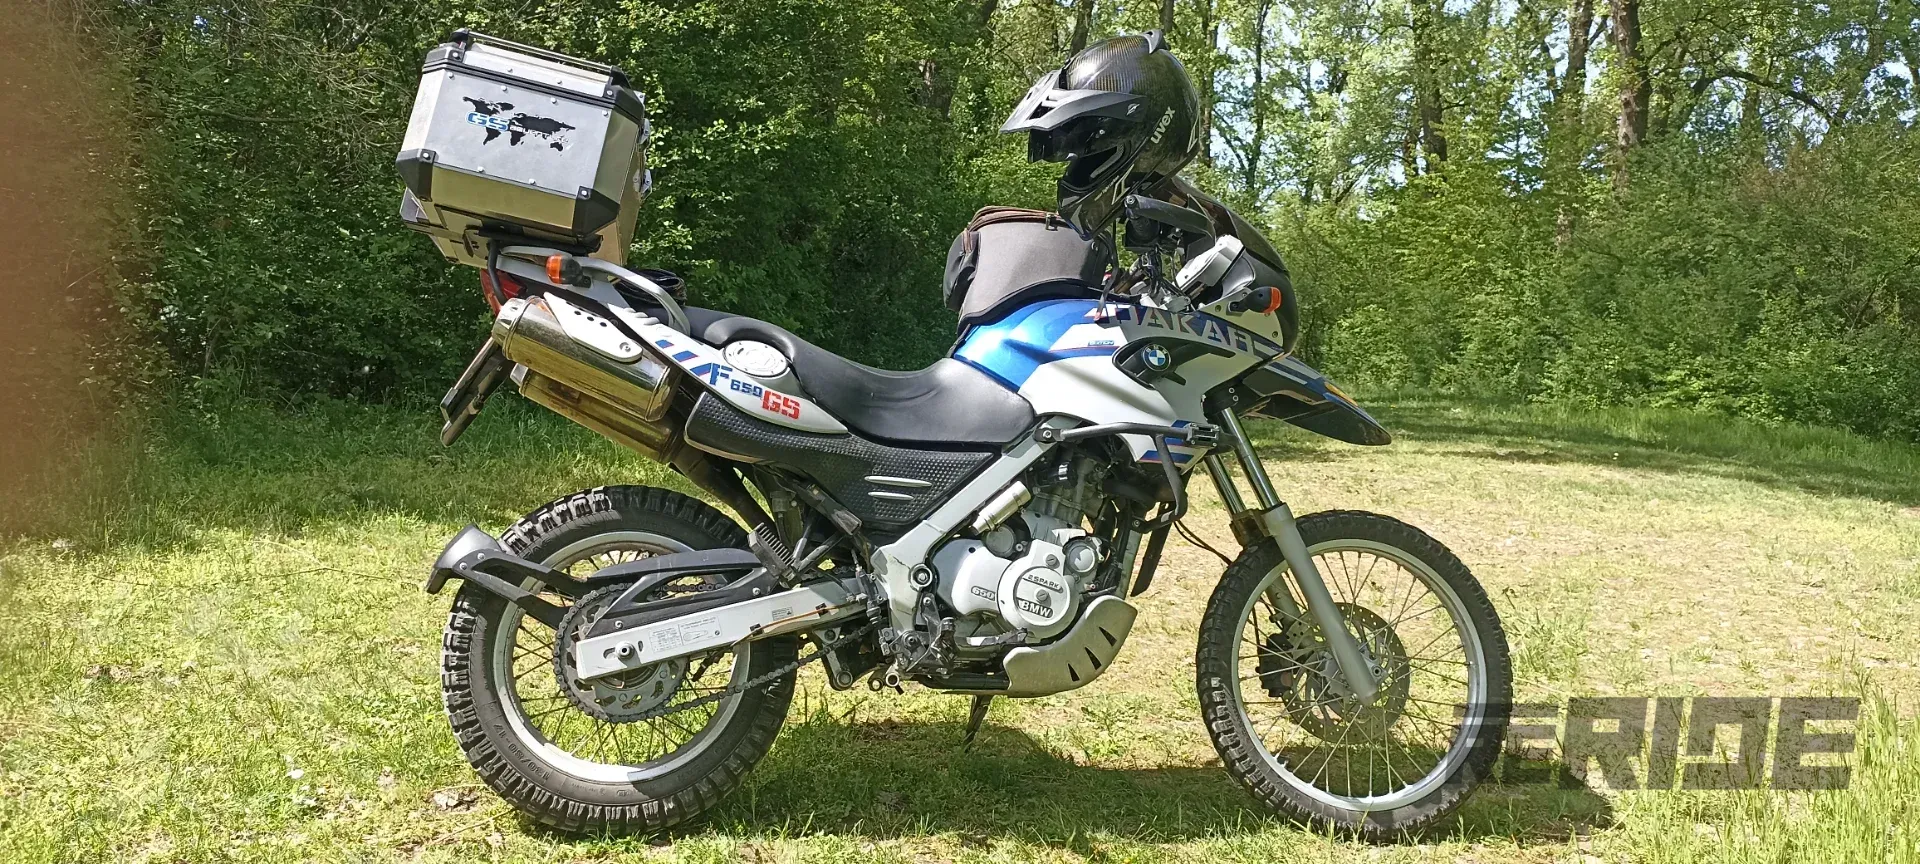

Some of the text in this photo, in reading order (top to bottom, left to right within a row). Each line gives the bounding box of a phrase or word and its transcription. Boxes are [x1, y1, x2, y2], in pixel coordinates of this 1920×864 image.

[467, 112, 509, 131] GS
[1150, 106, 1175, 144] uvex
[1108, 304, 1255, 356] DAKAR
[710, 363, 801, 420] F 650 GS
[972, 586, 995, 599] 650
[1020, 600, 1051, 617] BMW
